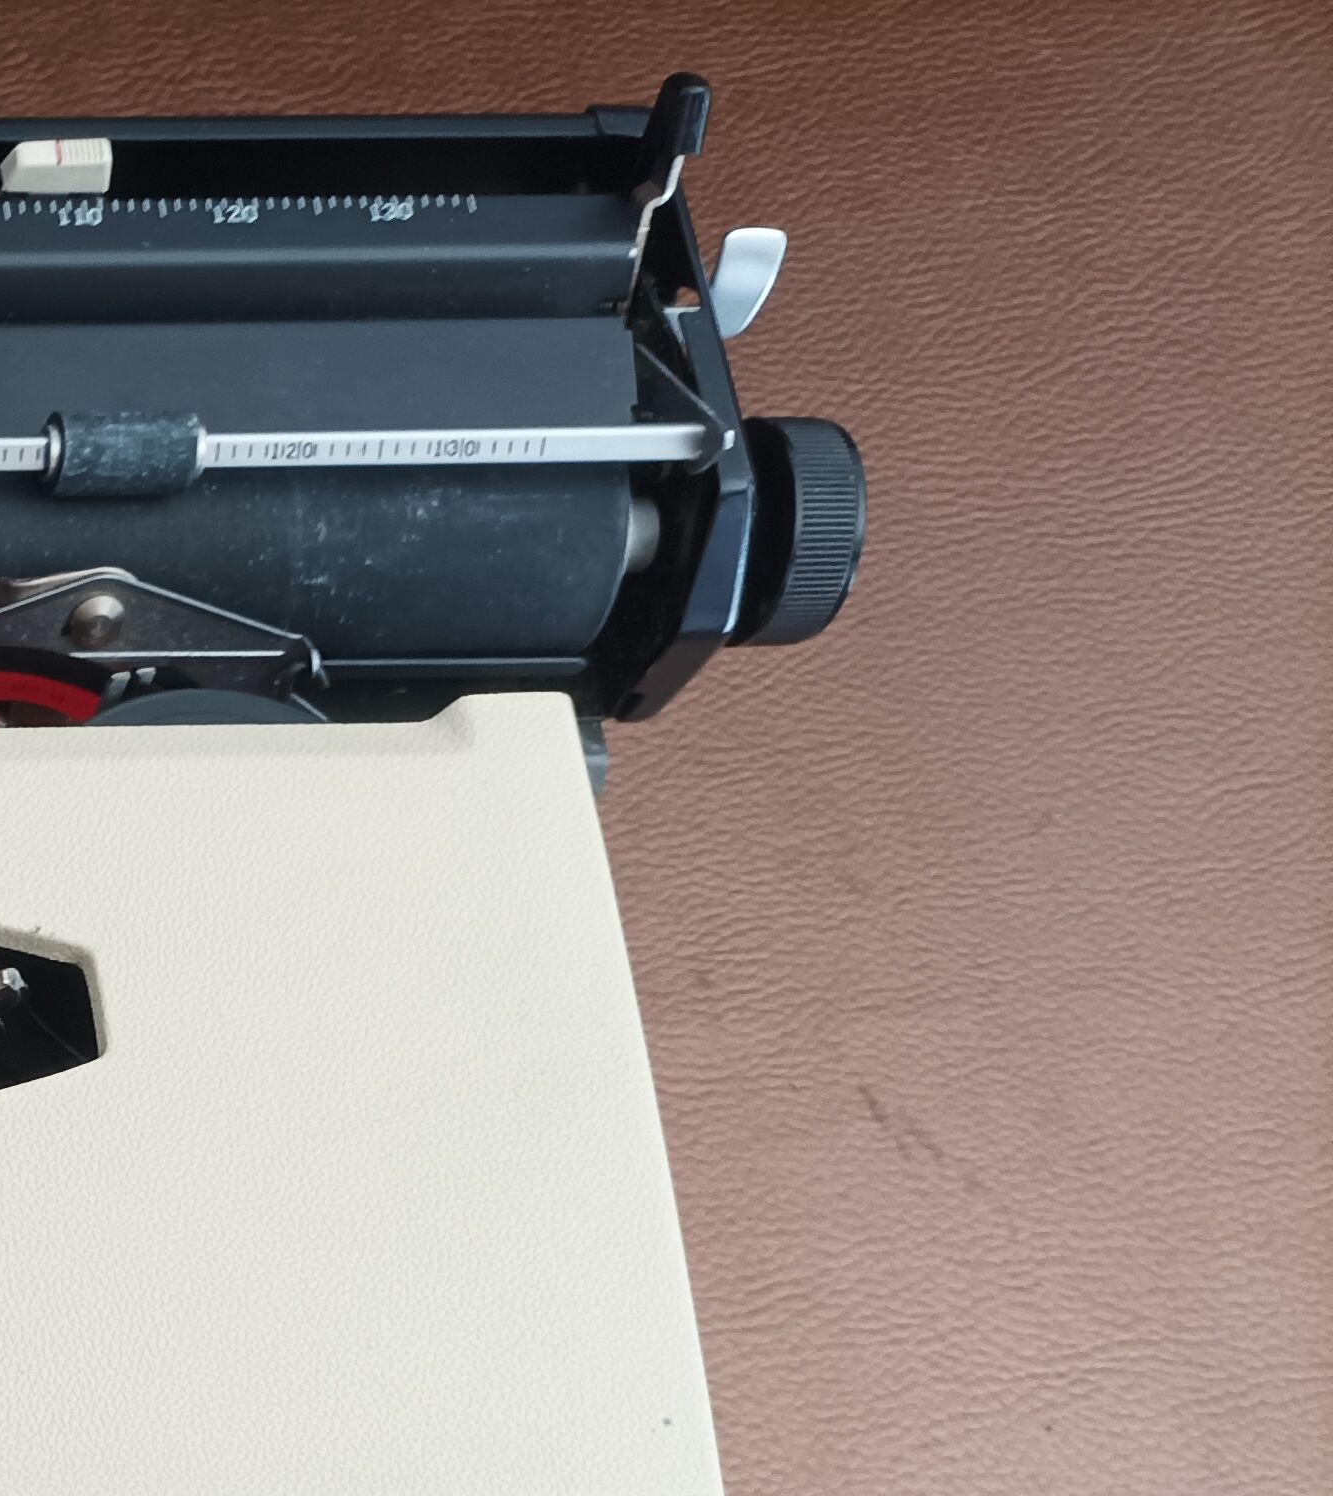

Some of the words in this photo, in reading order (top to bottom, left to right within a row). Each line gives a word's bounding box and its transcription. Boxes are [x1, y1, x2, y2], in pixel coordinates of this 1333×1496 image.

[57, 207, 103, 228] 110
[213, 204, 259, 225] 120
[271, 441, 313, 460] 120
[434, 438, 477, 458] 130
